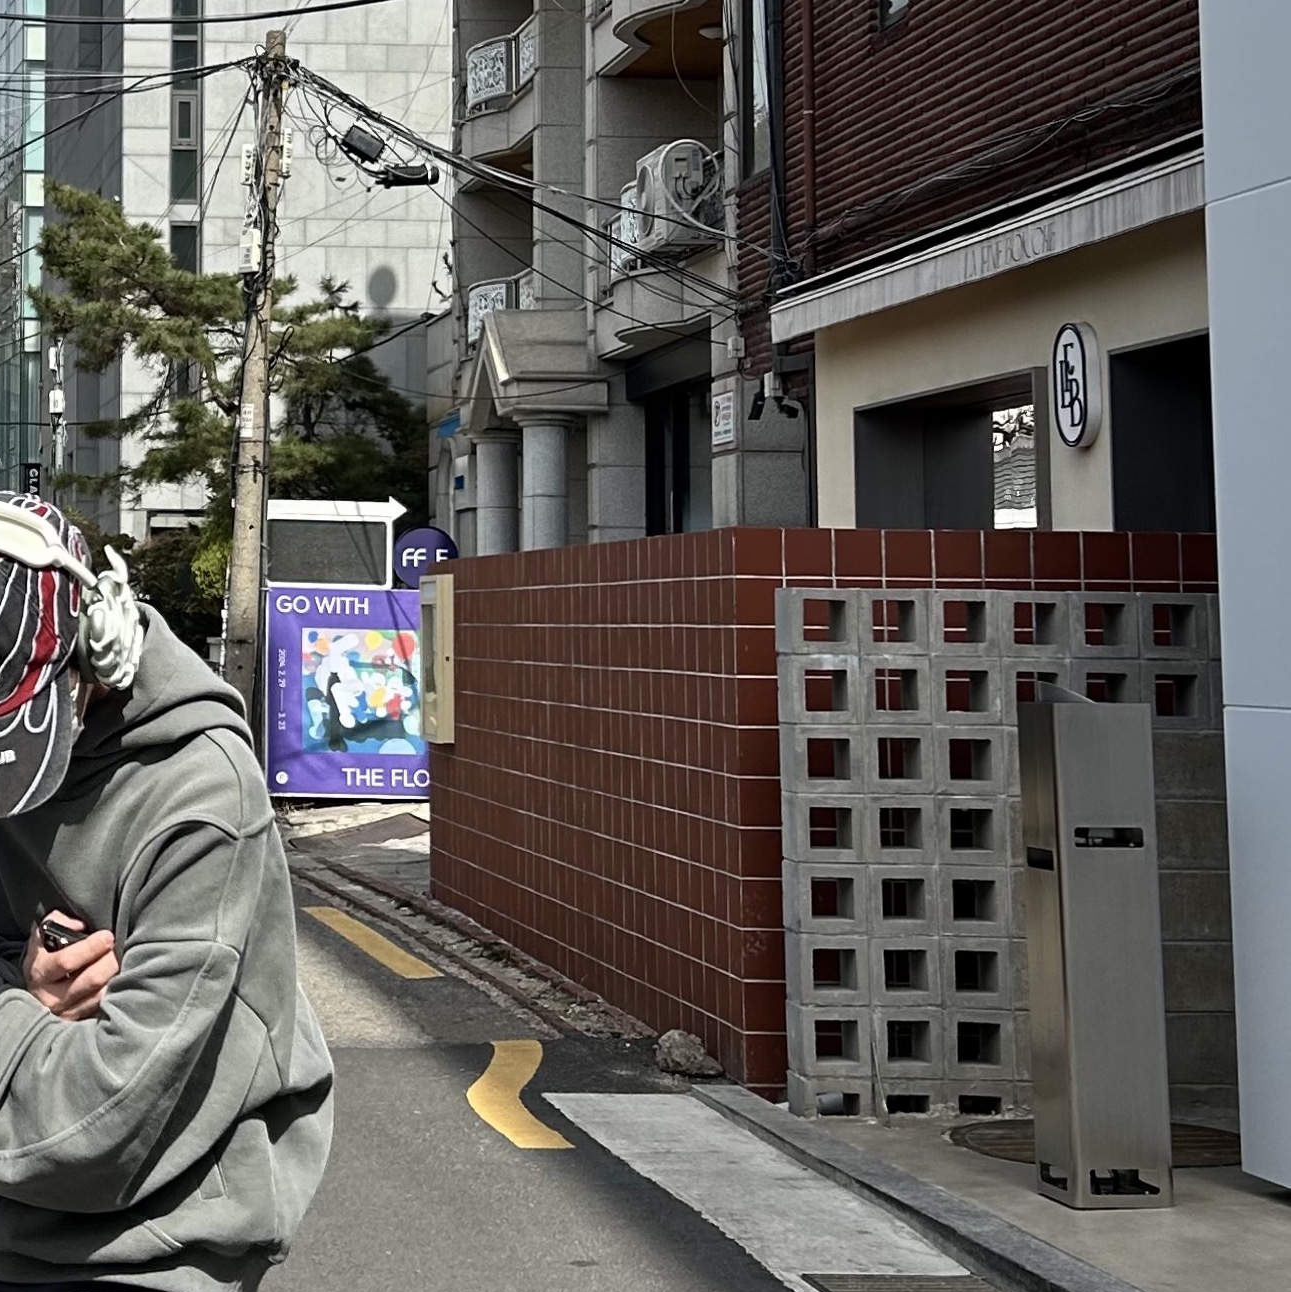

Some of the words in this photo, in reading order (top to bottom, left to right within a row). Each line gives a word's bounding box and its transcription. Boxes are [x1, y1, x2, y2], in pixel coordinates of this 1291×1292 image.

[276, 595, 310, 614] GO
[314, 596, 369, 615] WITH
[341, 767, 385, 787] THE
[391, 768, 430, 788] FLO
